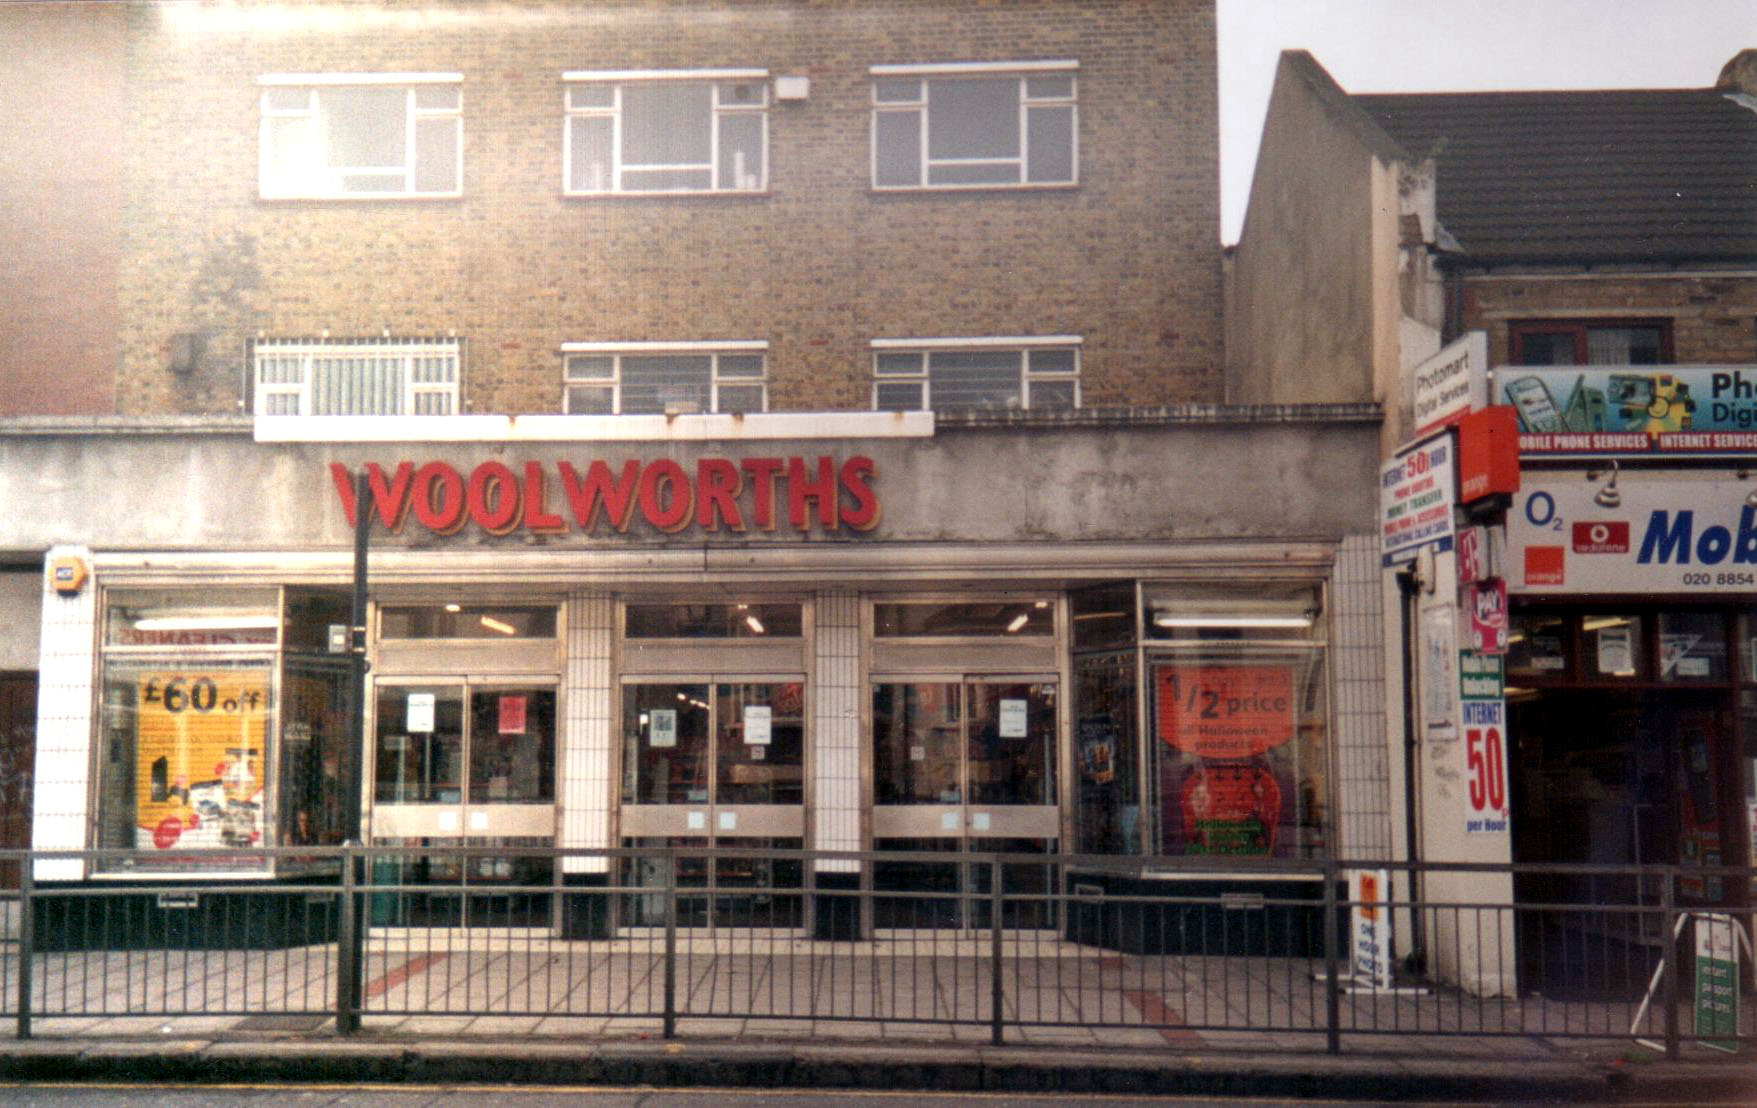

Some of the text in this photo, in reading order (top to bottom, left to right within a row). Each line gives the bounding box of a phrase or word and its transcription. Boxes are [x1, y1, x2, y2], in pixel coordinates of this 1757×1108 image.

[1712, 371, 1757, 398] Ph
[1519, 434, 1648, 449] OBILE PHONE SERVICES
[1660, 434, 1709, 448] INTERNET
[330, 456, 882, 537] WOOLWORTHS
[1525, 491, 1563, 531] O2
[1636, 505, 1757, 565] Mob
[1576, 543, 1626, 553] vodafone
[1683, 573, 1754, 585] 020 8854
[1477, 589, 1500, 620] PAY
[144, 676, 260, 713] £60 off
[1227, 691, 1287, 716] price
[1463, 703, 1501, 724] INTERNET
[1467, 817, 1506, 832] per Hour
[1703, 983, 1732, 996] pasport
